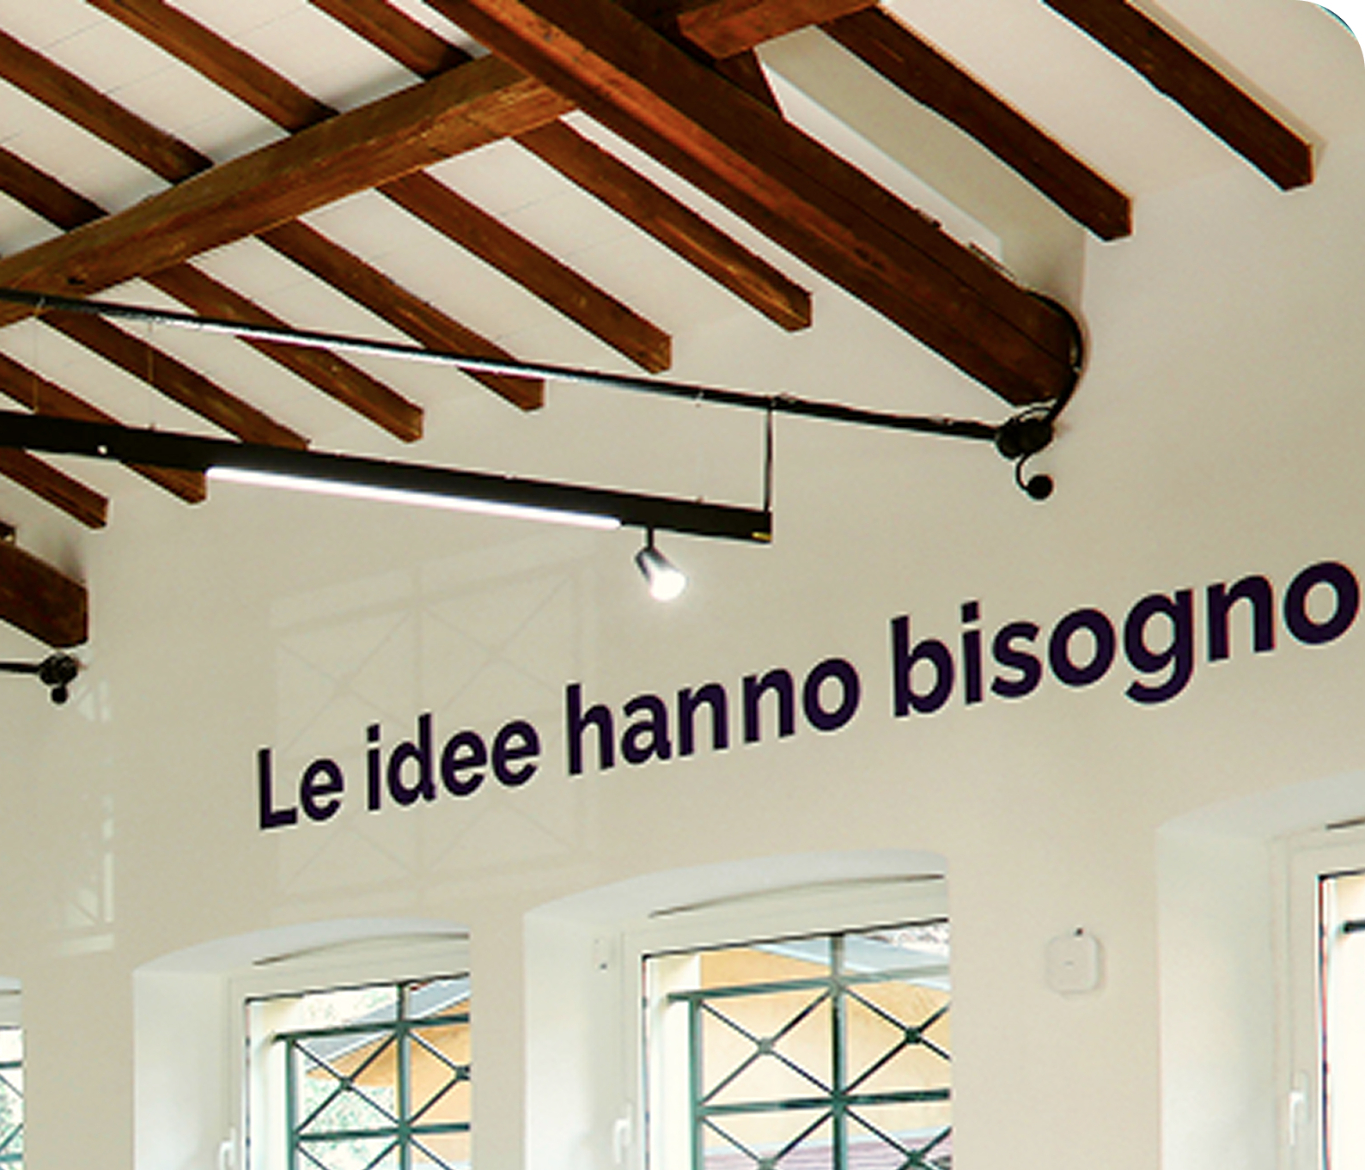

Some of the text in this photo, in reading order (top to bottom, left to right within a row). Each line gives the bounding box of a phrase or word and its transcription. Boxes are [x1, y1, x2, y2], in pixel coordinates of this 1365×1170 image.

[257, 561, 1361, 831] Le idee hanno bisogno
